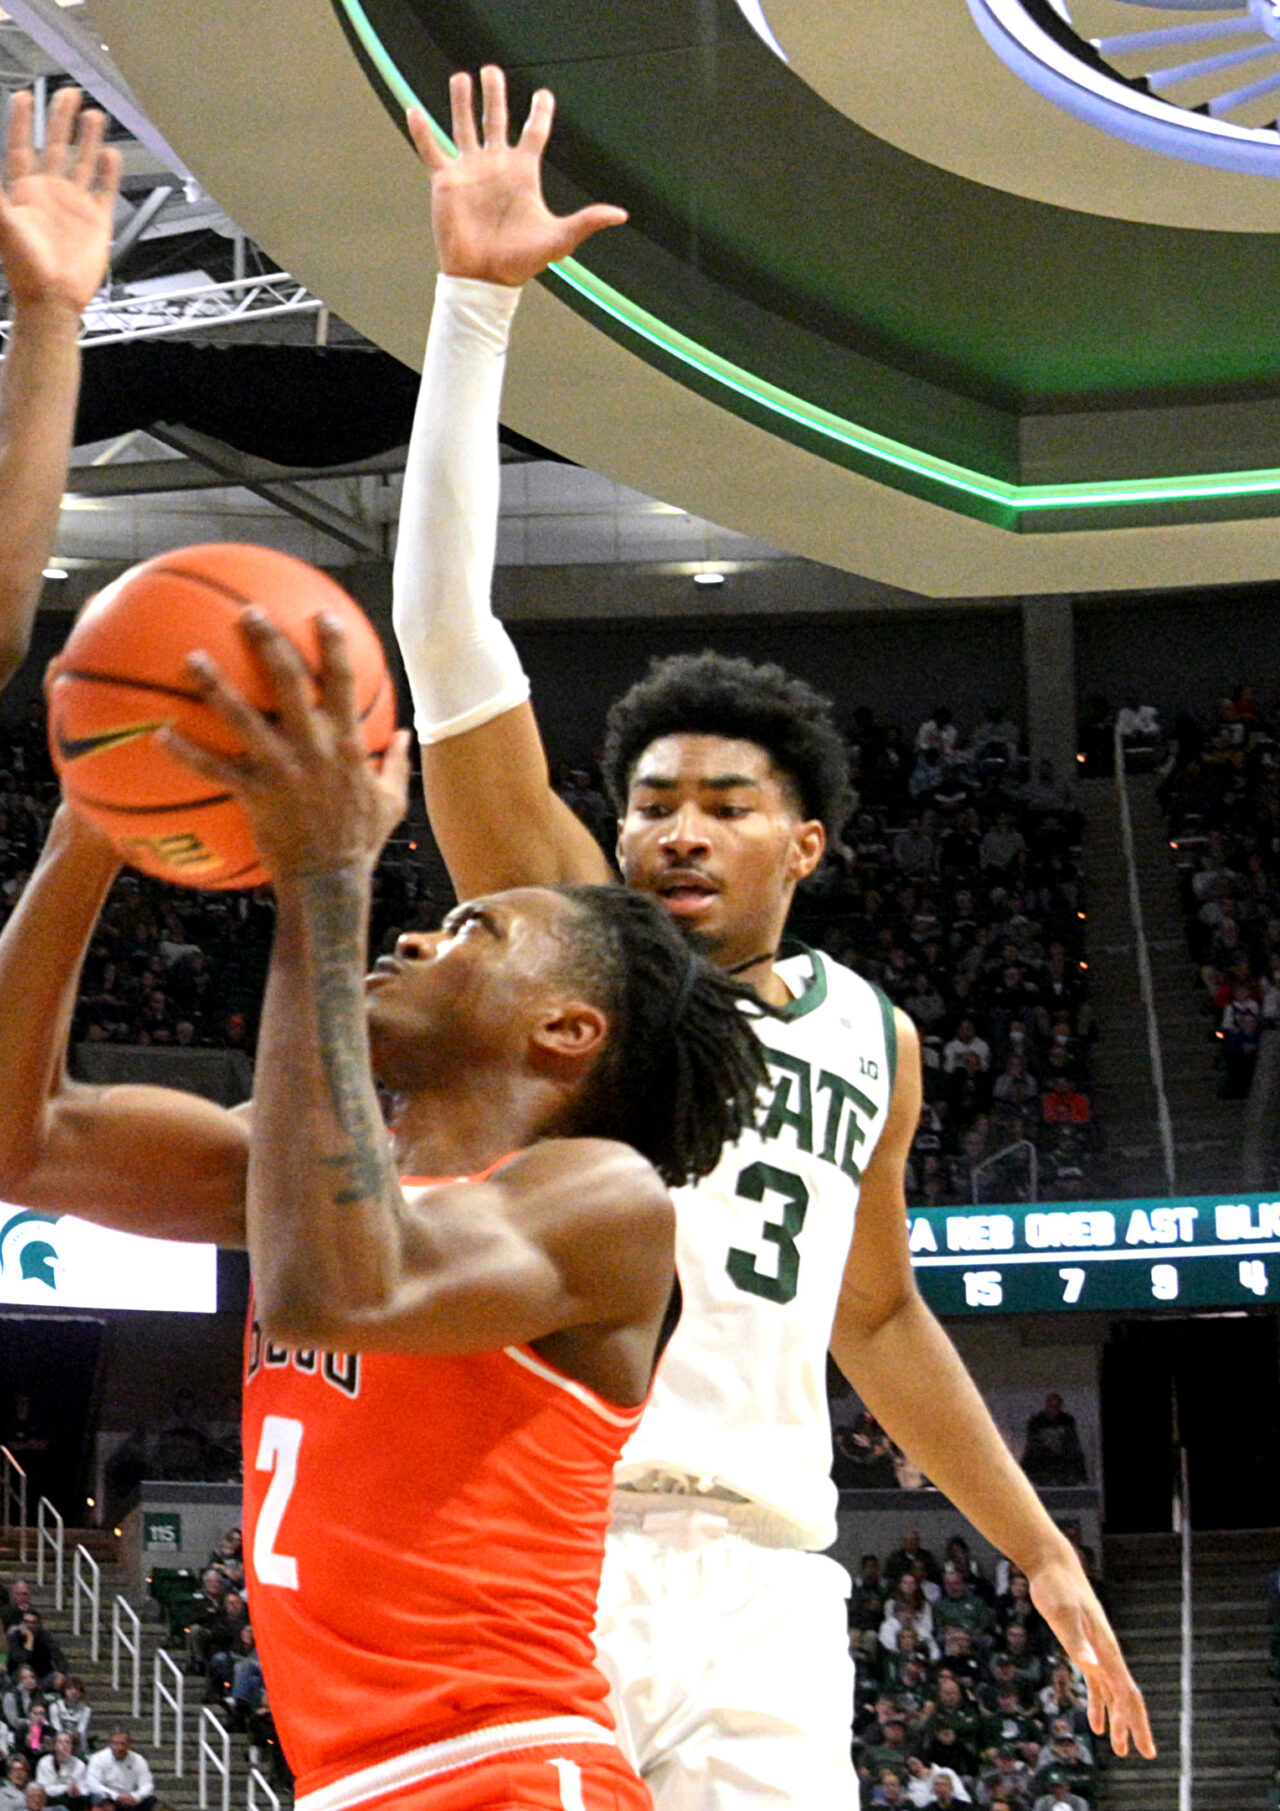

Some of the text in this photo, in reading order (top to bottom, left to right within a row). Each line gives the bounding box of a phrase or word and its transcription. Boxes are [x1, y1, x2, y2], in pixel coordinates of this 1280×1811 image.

[762, 1046, 880, 1188] ATE
[725, 1160, 810, 1305] 3
[963, 1260, 1269, 1307] 15 7 9 4
[1125, 1207, 1198, 1245] AST
[253, 1415, 304, 1591] 2
